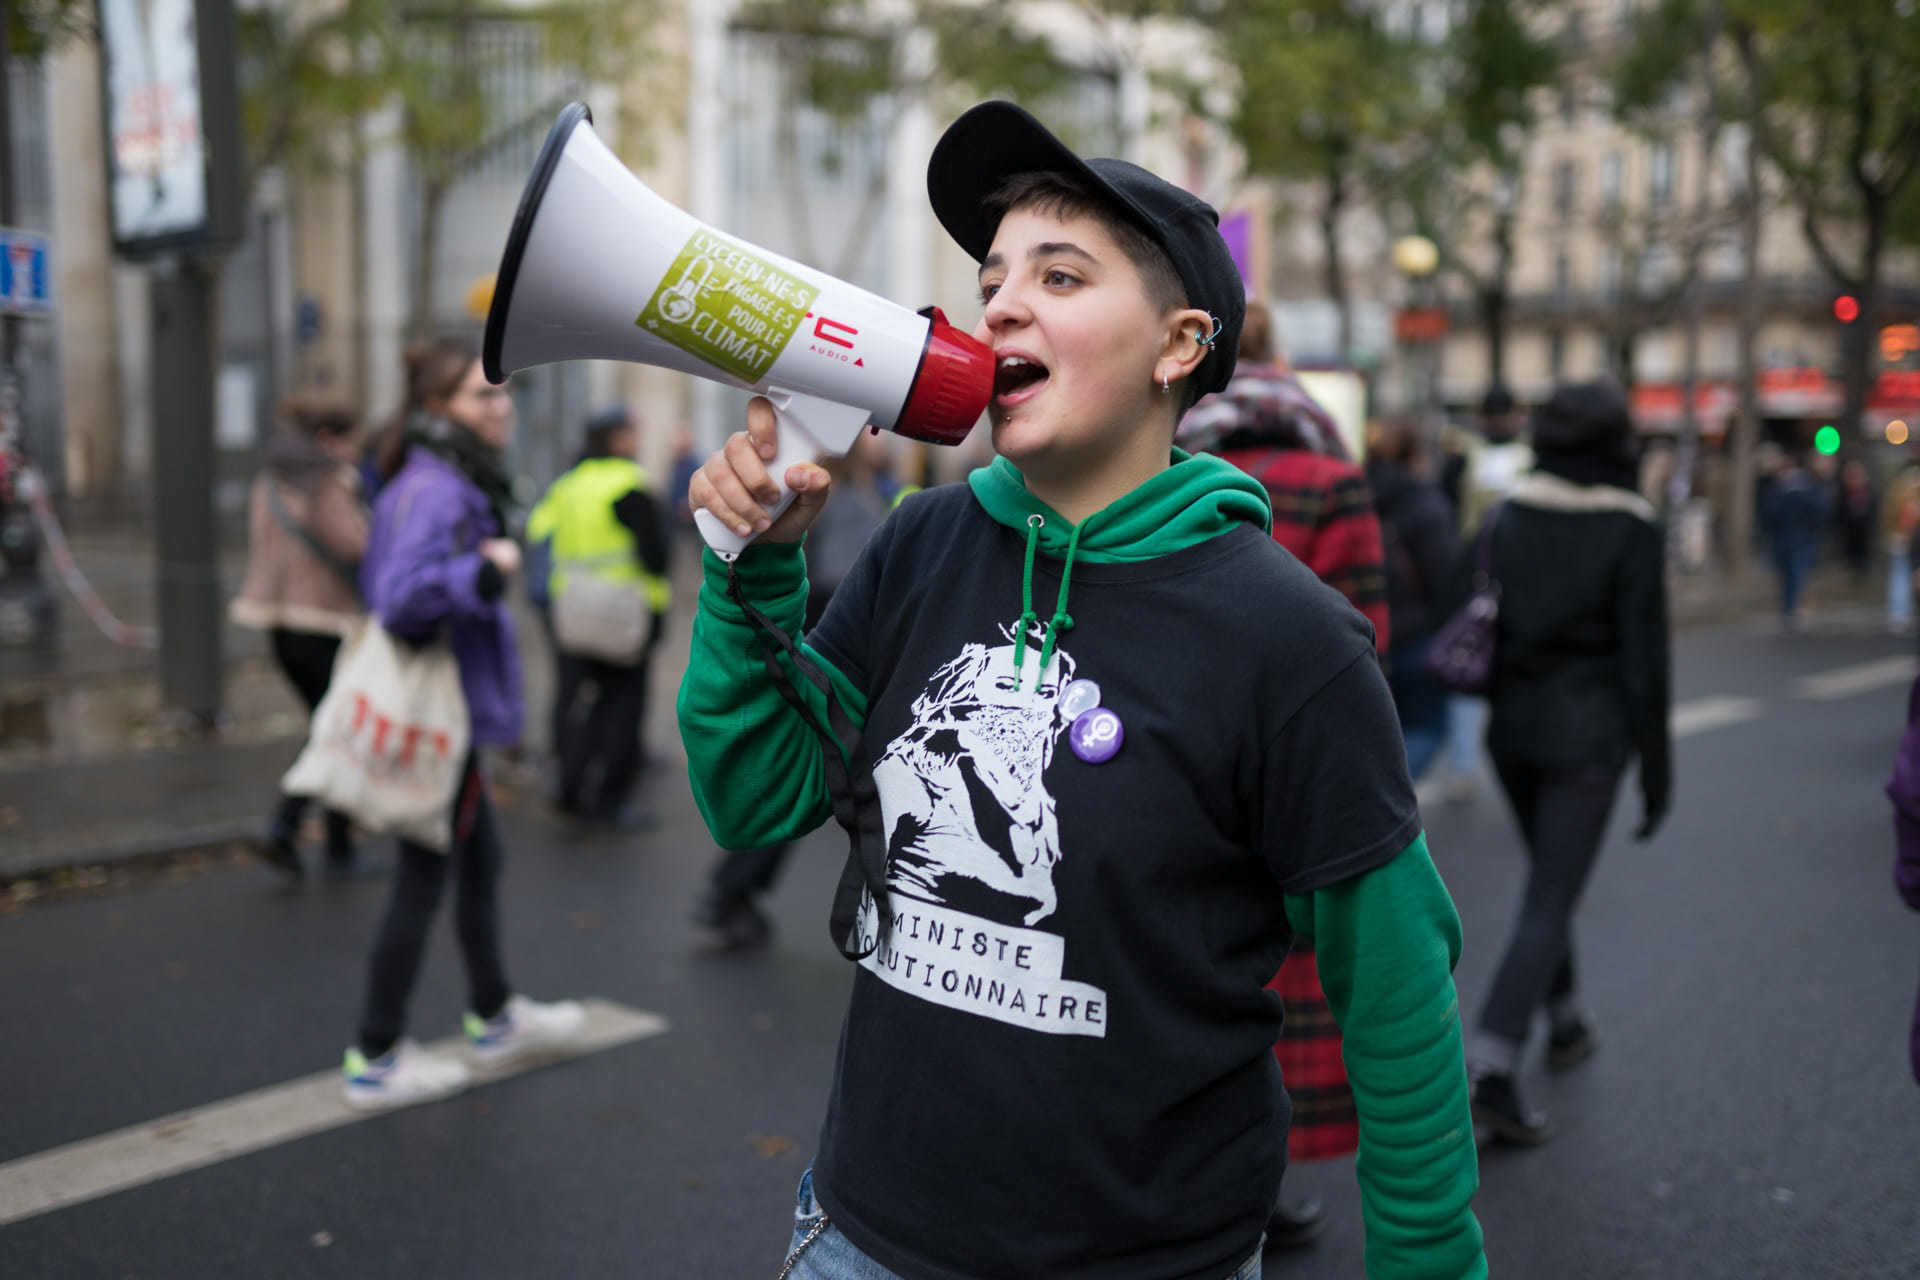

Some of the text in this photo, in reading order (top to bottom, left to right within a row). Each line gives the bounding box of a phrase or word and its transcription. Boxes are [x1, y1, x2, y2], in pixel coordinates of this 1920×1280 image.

[691, 311, 772, 369] CLIMAT
[727, 304, 785, 349] POUR LE
[809, 344, 849, 362] AUDIO
